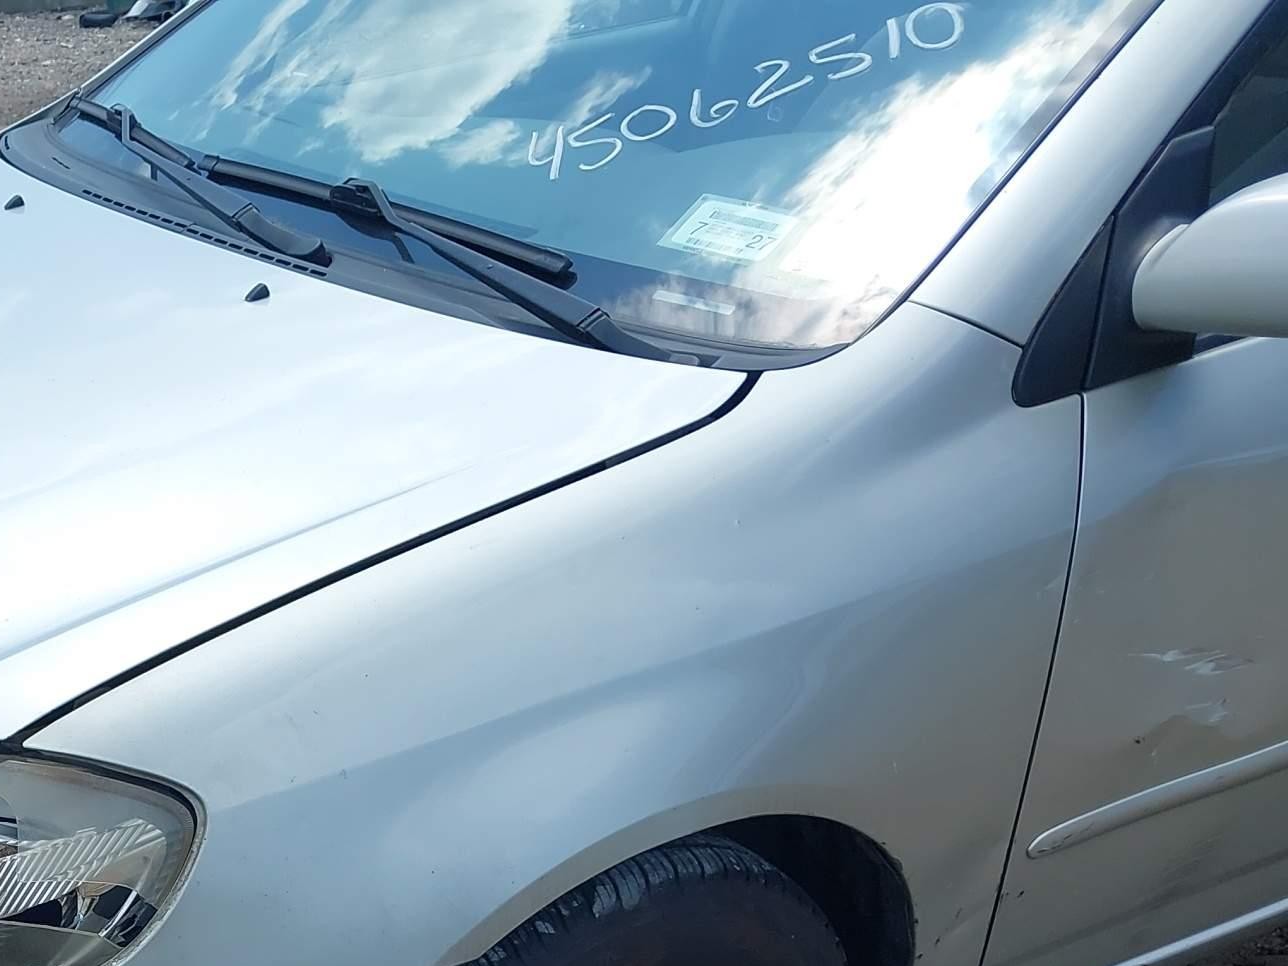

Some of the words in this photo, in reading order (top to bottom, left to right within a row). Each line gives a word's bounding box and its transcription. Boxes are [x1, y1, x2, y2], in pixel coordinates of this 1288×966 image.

[528, 2, 965, 180] 45062510
[690, 221, 709, 235] 7
[746, 234, 777, 250] 27
